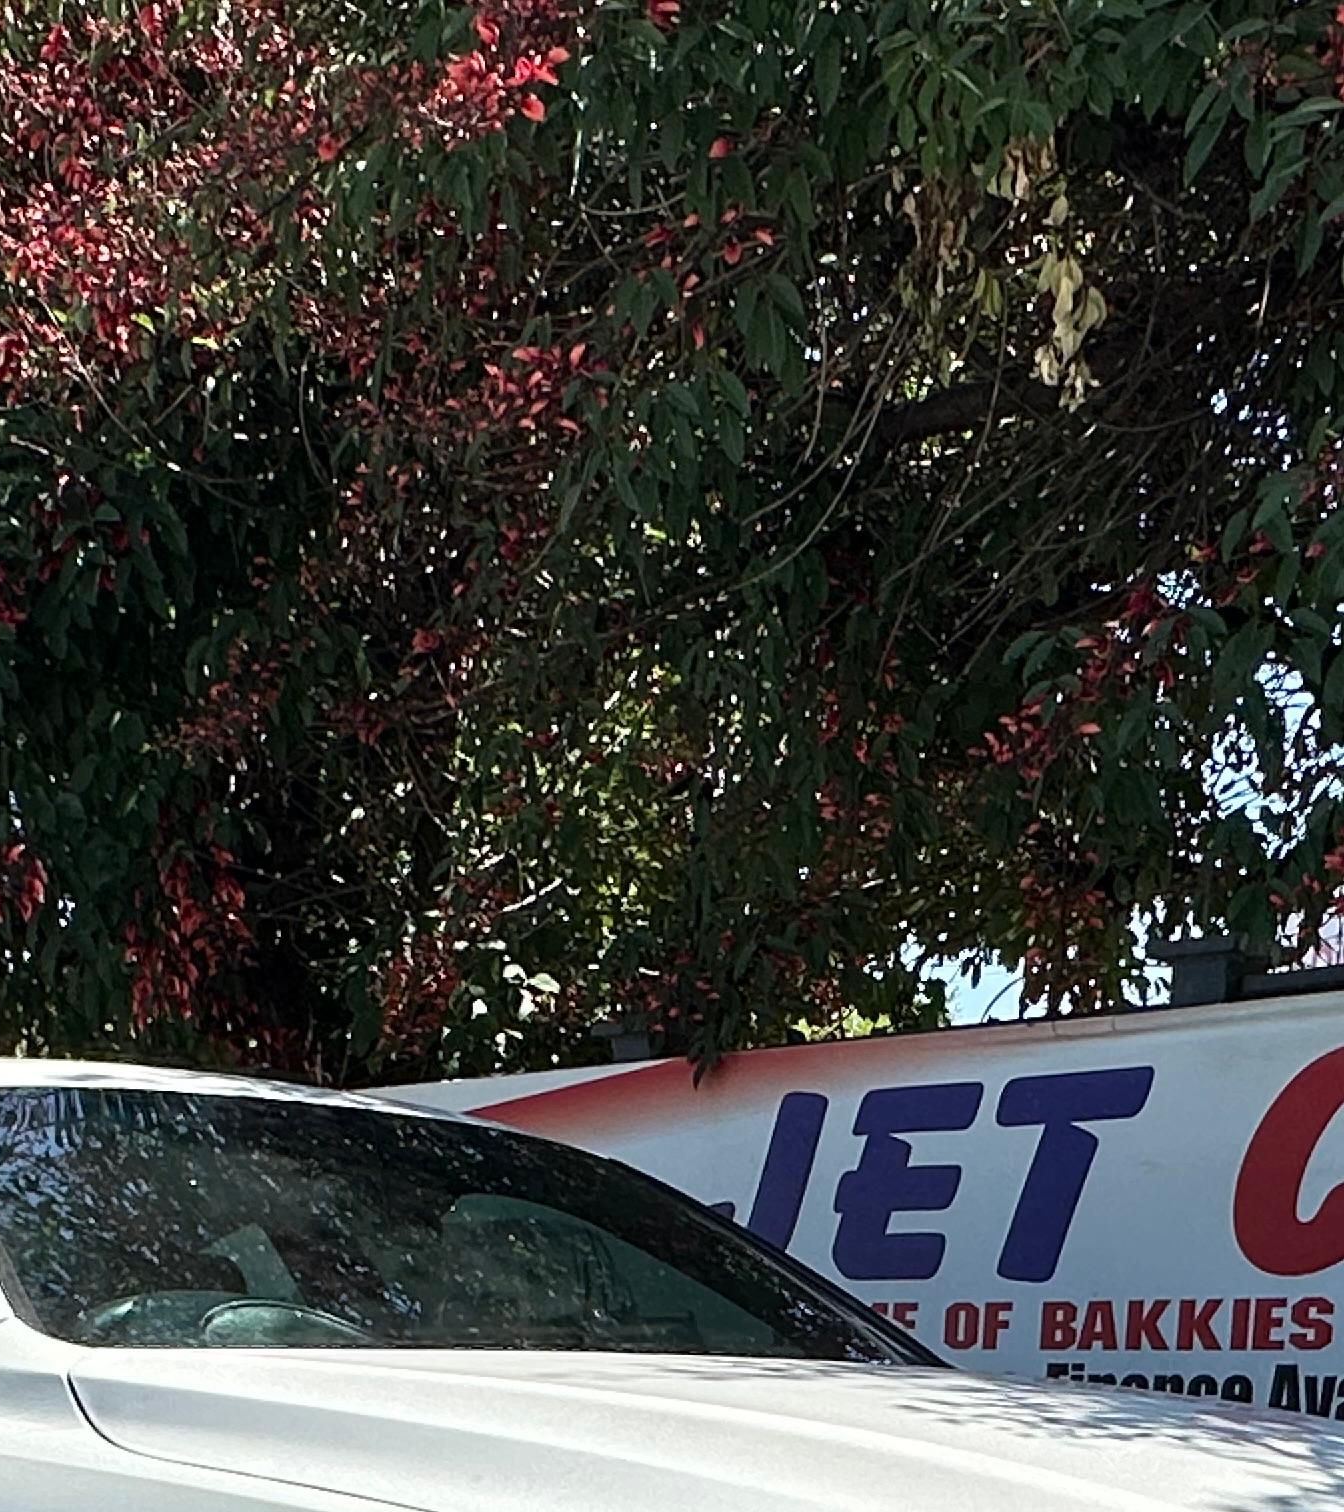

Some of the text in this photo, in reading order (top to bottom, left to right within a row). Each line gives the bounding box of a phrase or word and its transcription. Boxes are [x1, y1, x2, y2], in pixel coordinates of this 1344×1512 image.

[706, 1066, 1155, 1283] JET
[942, 1301, 1014, 1350] OF
[1039, 1294, 1335, 1351] BAKKIES
